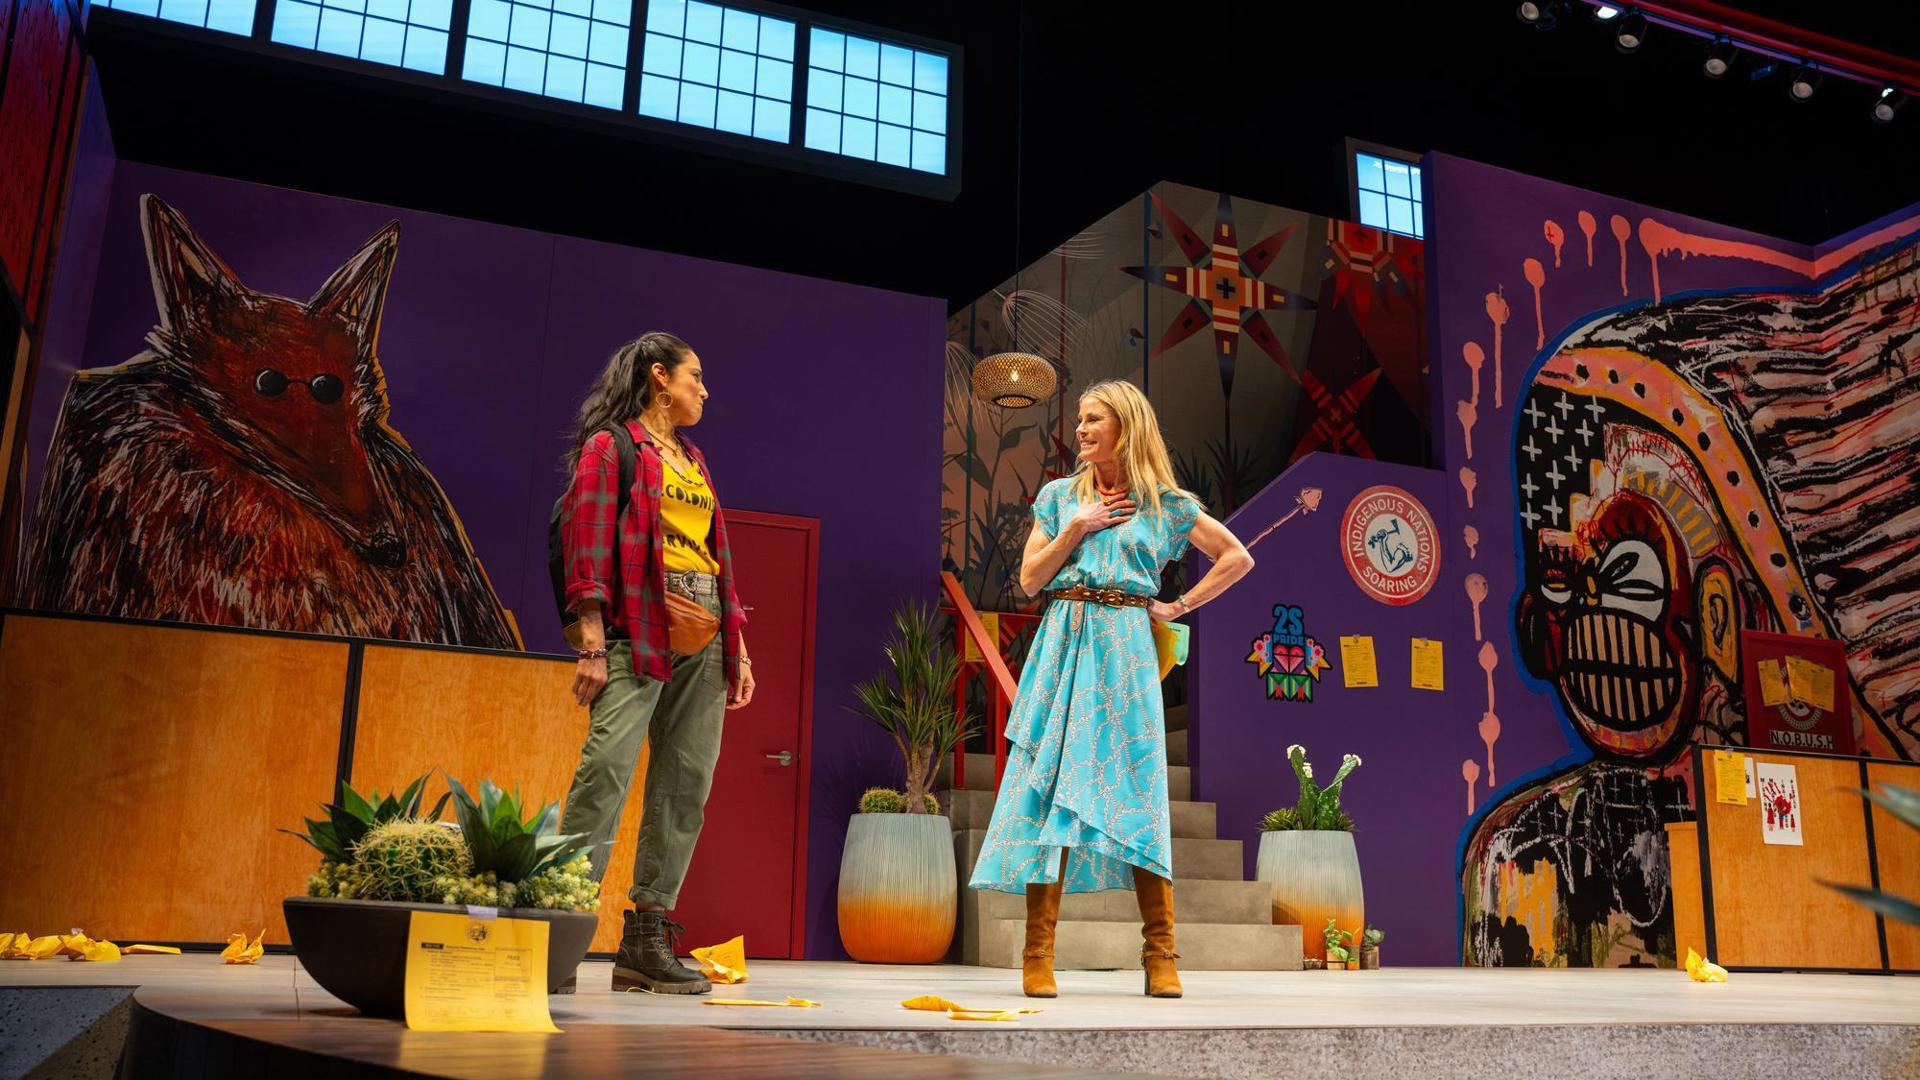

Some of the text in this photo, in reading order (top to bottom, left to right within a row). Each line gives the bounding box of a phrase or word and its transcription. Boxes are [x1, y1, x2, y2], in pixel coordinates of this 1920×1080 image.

[1352, 499, 1431, 573] INDIGENOUS NATIONS
[1363, 575, 1417, 593] SOARING
[1273, 605, 1303, 635] 2S
[1273, 634, 1304, 646] PRIDE
